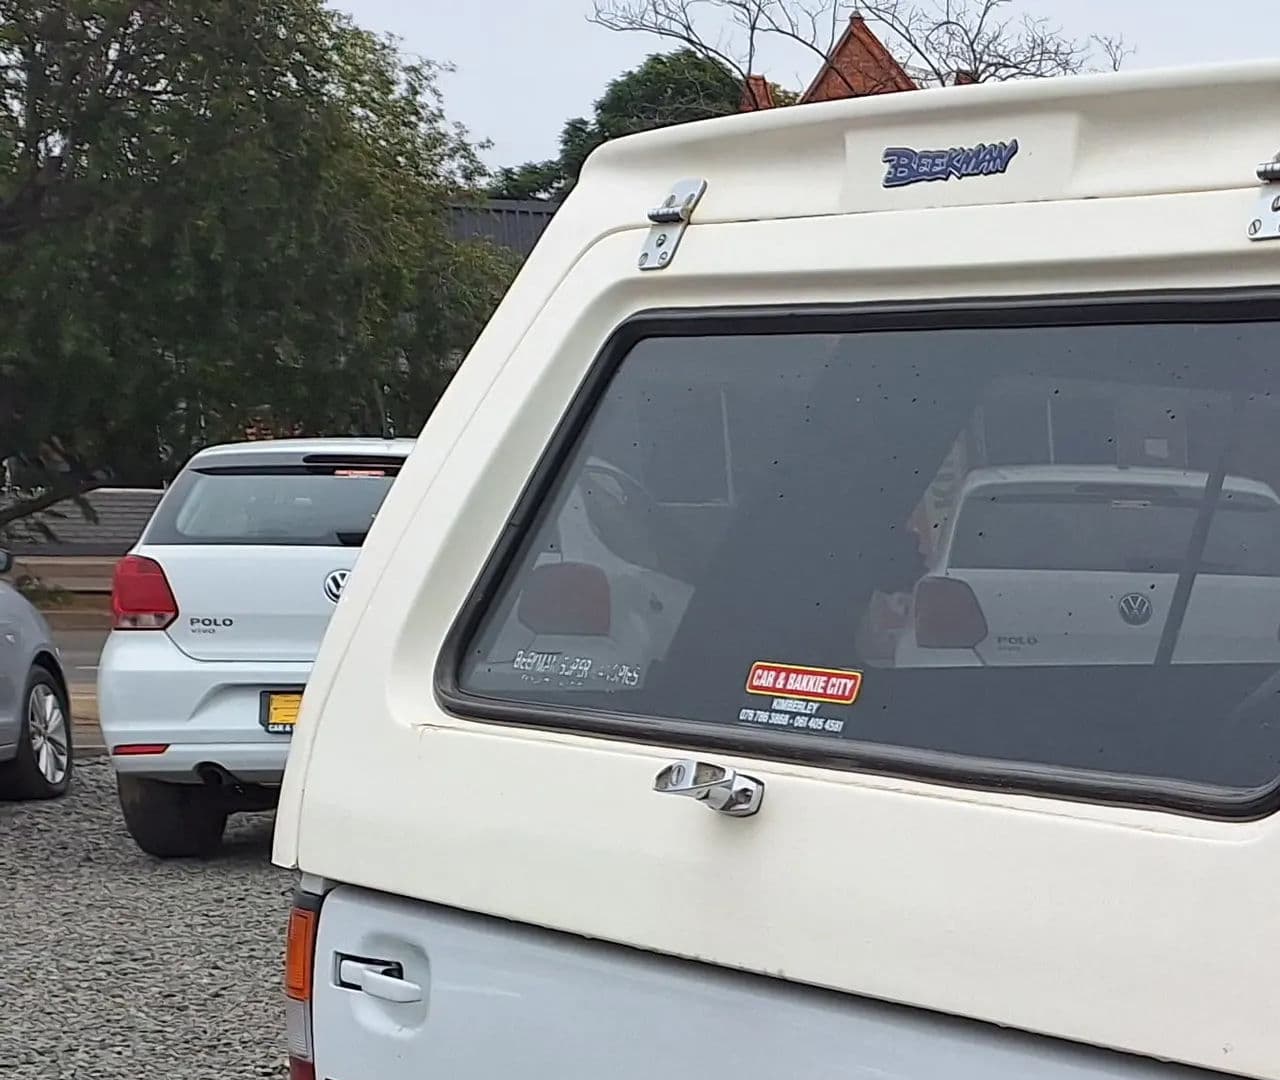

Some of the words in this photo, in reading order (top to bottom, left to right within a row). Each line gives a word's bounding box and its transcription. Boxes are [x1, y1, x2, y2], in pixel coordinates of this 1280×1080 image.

[882, 138, 1019, 188] BEEKMAN
[190, 617, 234, 628] POLO
[752, 668, 776, 687] CAR
[775, 671, 786, 689] &
[786, 673, 828, 693] BAKKIE
[826, 678, 855, 696] CITY
